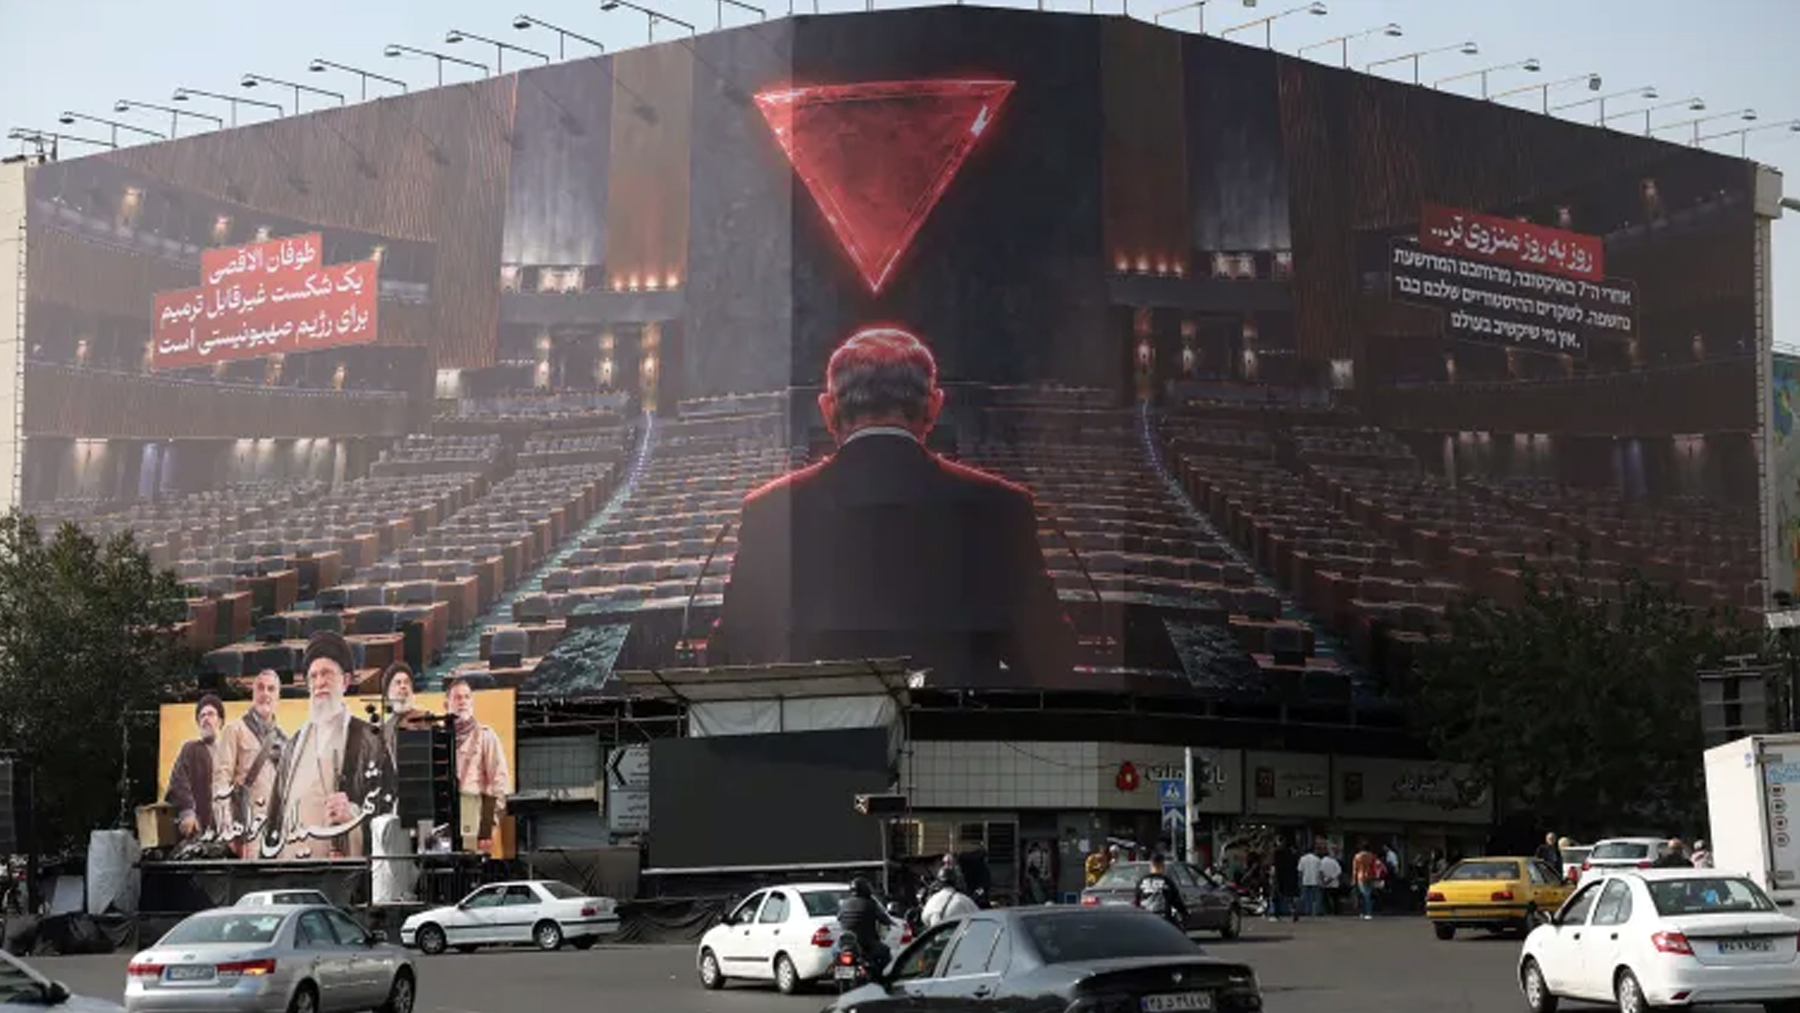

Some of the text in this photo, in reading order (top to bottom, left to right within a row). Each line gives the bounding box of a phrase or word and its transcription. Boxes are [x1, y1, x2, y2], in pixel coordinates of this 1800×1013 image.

[1464, 222, 1519, 255] منزوی
[1520, 231, 1547, 263] روز
[208, 240, 316, 284] طوفان الاقصی
[1393, 248, 1457, 274] המרושעת
[1566, 241, 1594, 273] روز
[270, 273, 332, 302] شکست
[335, 268, 364, 295] یک
[1394, 275, 1421, 294] כבר
[1422, 277, 1460, 300] שלכם
[1601, 286, 1631, 305] אחרי
[159, 294, 204, 330] ترمیم
[1450, 308, 1492, 333] בעולם
[1536, 302, 1584, 323] לשקרים
[158, 304, 369, 356] برای رژیم صهیونیستی است
[1541, 327, 1556, 343] מי
